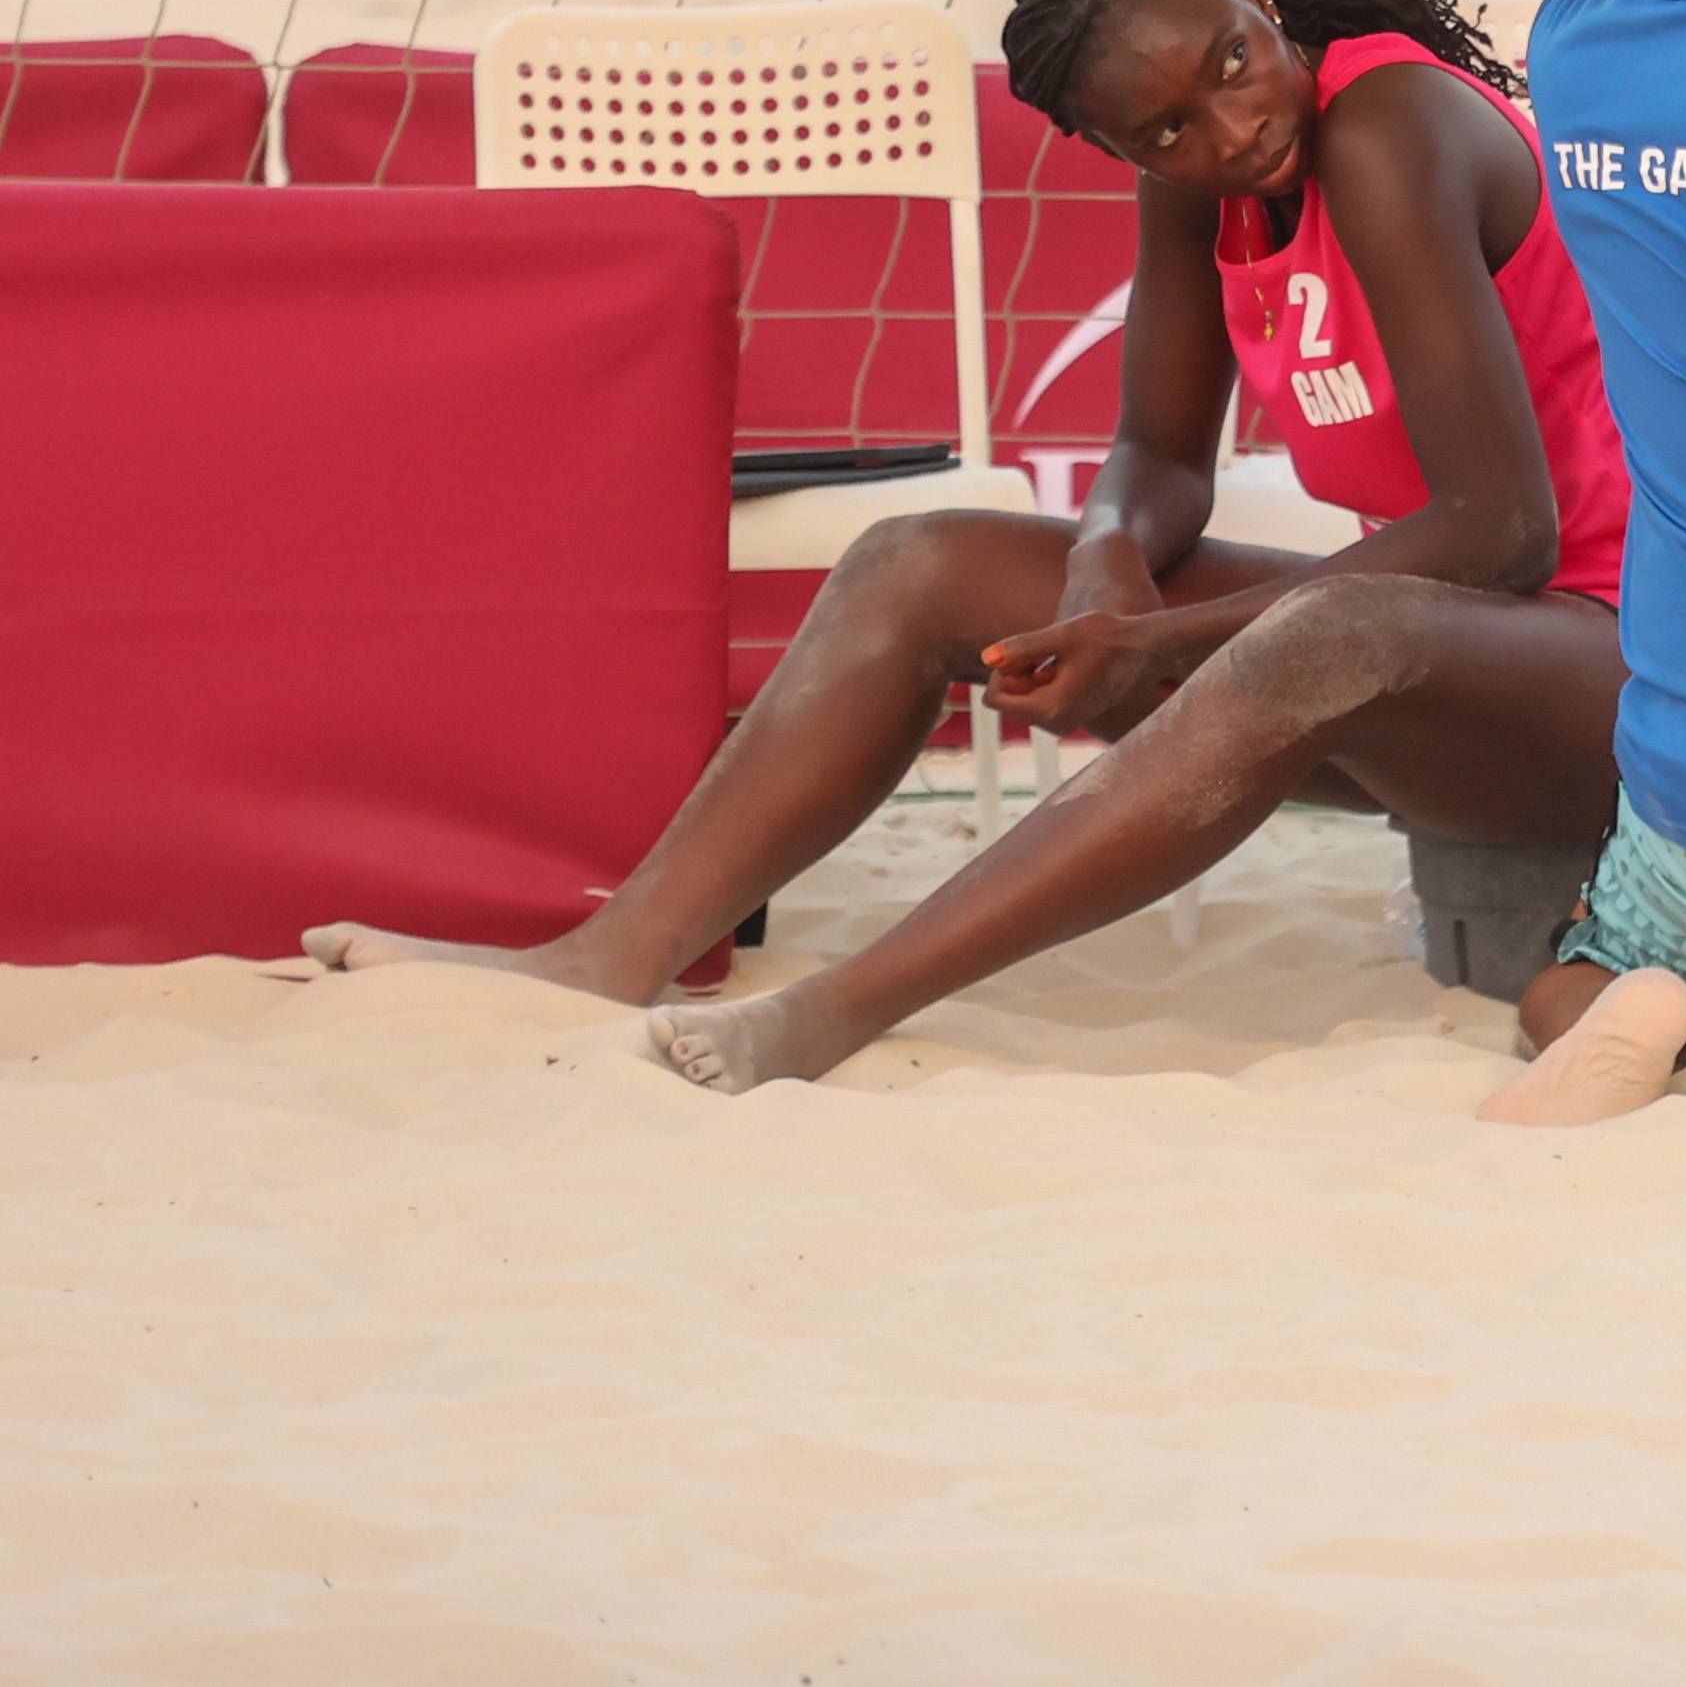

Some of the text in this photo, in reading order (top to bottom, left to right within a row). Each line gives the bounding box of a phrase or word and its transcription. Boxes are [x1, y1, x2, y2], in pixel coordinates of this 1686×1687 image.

[1553, 142, 1626, 191] THE
[1287, 272, 1332, 359] 2
[1290, 360, 1374, 427] GAM
